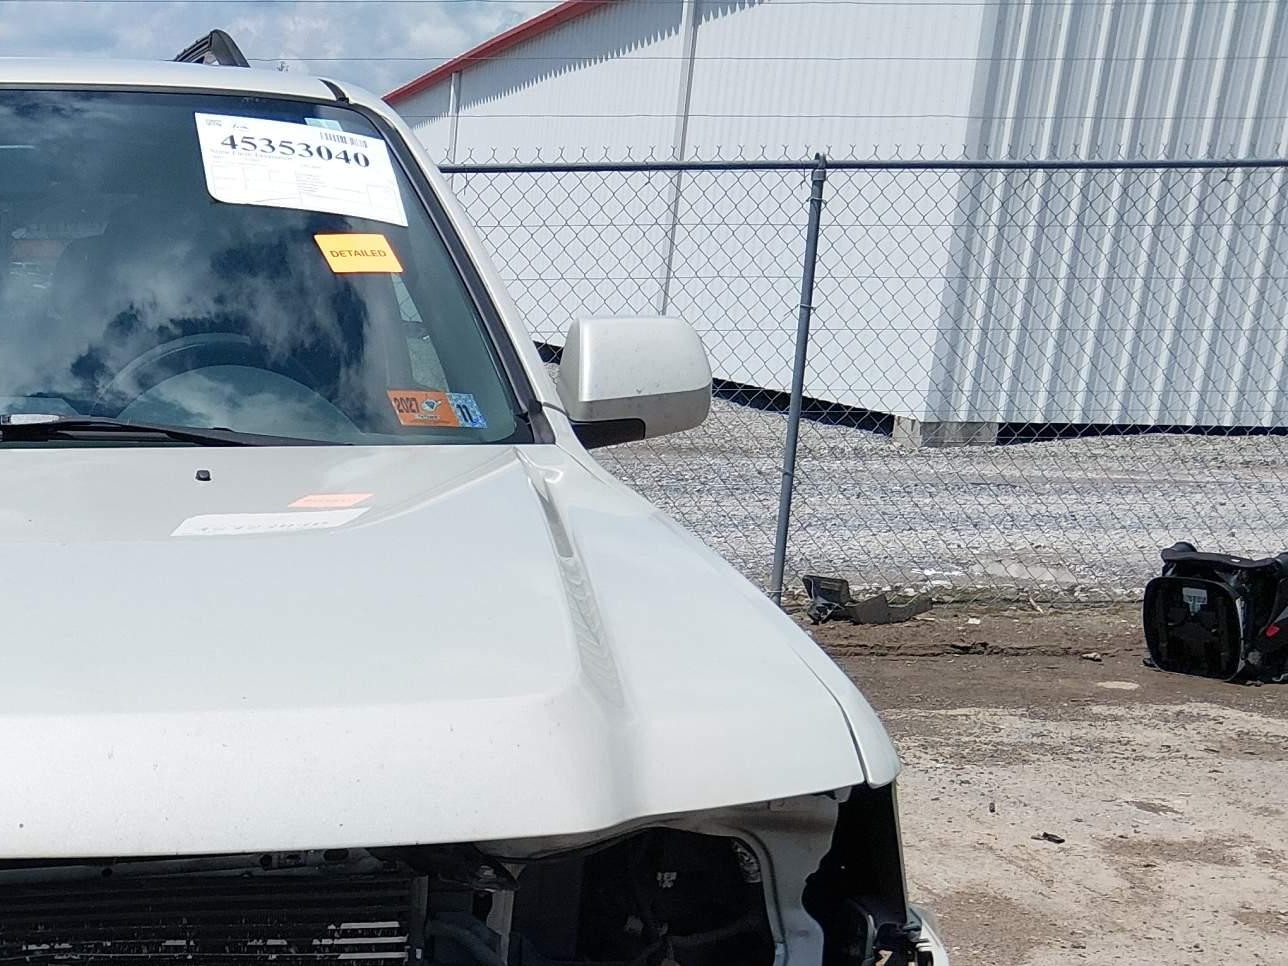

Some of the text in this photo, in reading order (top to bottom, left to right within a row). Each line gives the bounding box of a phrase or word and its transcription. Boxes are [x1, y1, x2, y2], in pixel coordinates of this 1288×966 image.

[220, 134, 370, 168] 45353040
[329, 249, 388, 258] DETAILED
[393, 397, 420, 413] 2027
[455, 404, 474, 422] 11
